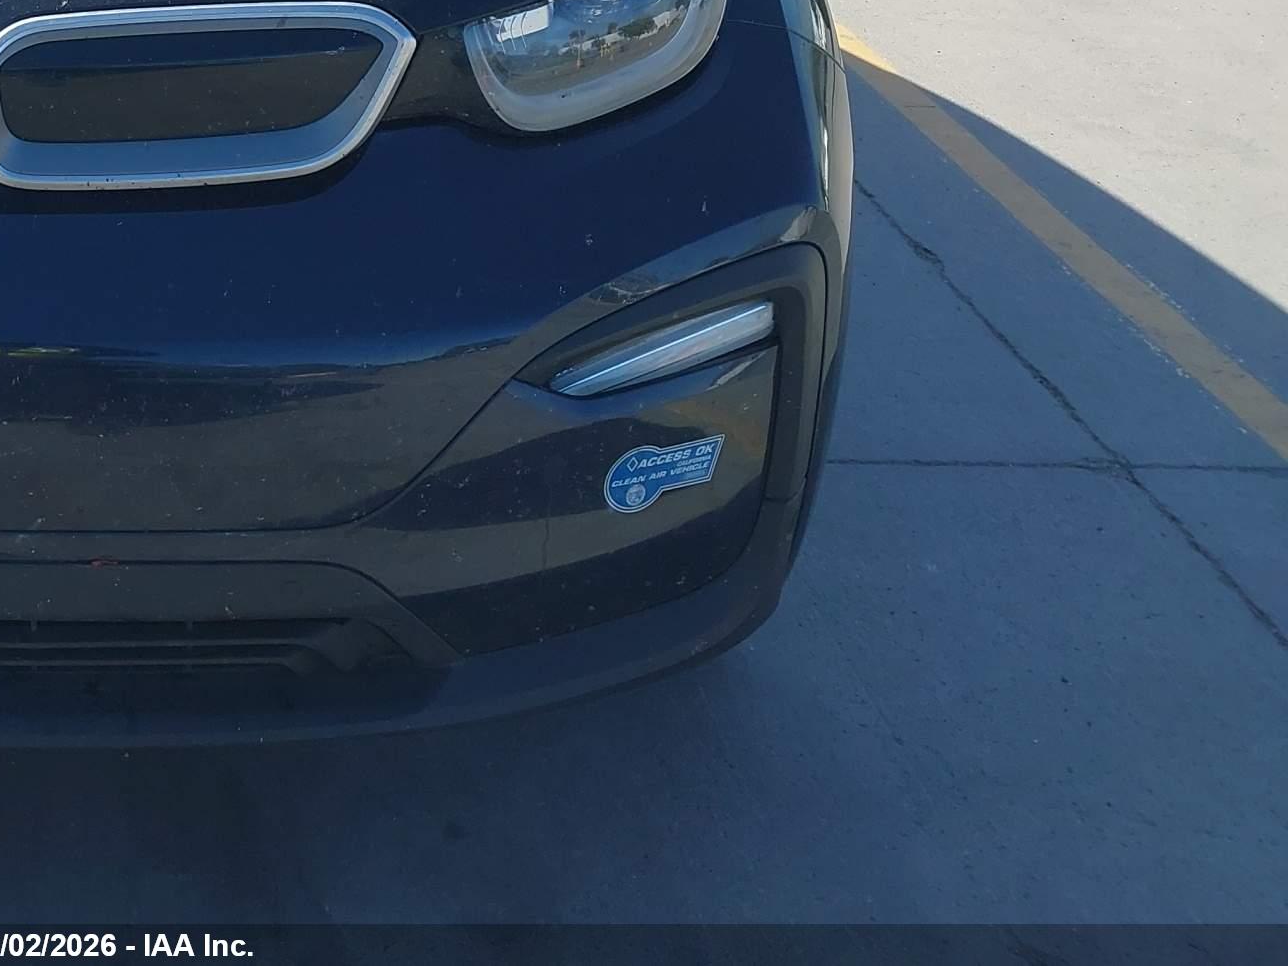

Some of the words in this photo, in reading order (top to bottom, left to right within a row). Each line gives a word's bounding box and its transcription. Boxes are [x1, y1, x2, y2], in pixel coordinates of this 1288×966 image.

[637, 449, 692, 469] ACCESS
[695, 443, 715, 455] OK
[612, 474, 646, 488] CLEAN
[648, 470, 667, 481] AIR
[670, 460, 711, 475] VEHICLE
